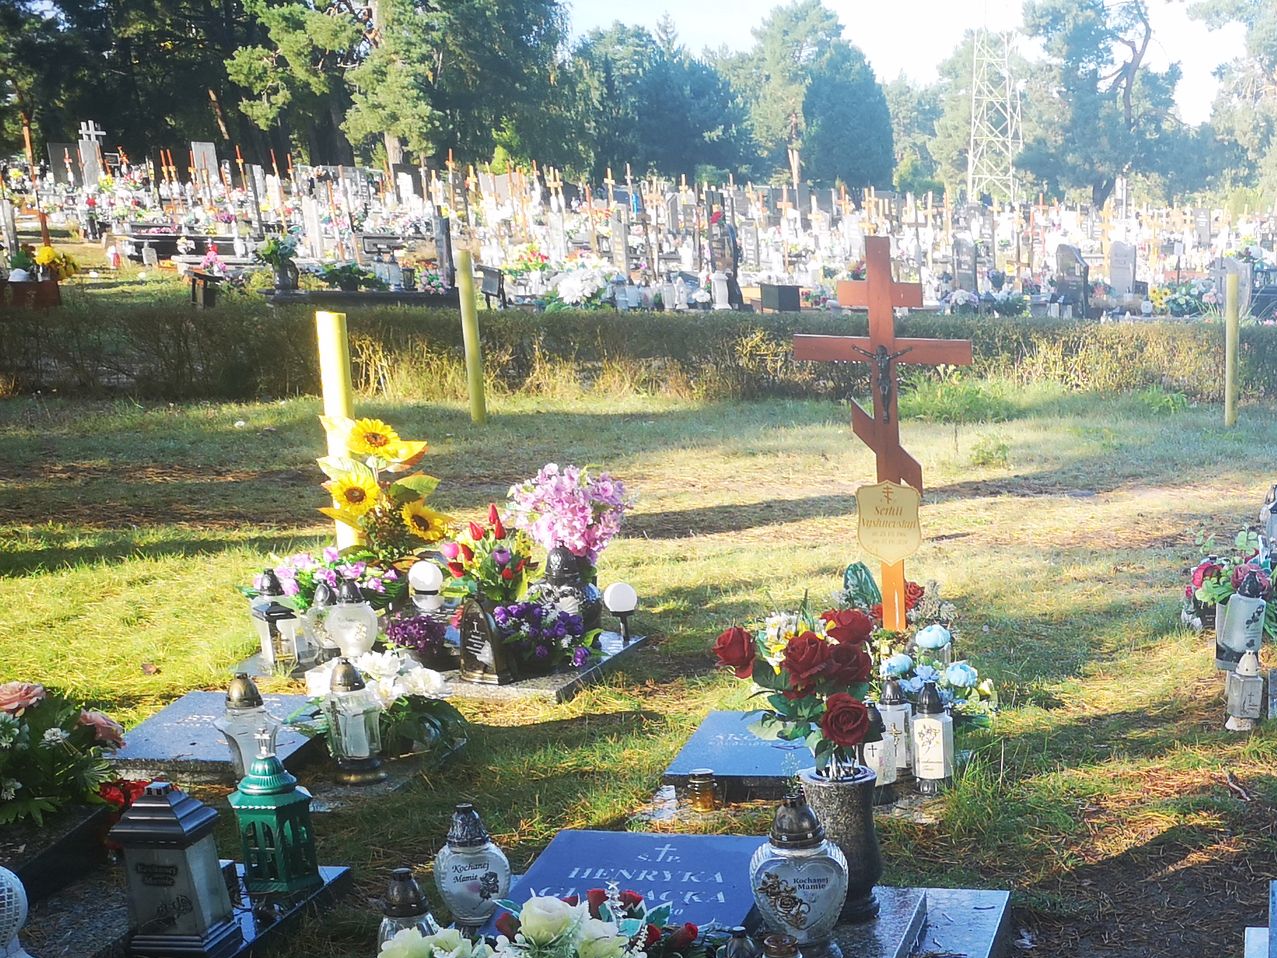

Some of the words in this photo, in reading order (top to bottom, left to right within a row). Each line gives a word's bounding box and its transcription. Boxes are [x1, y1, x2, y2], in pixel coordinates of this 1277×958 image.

[452, 862, 490, 875] Kochanej
[453, 874, 478, 884] Mamie
[568, 867, 724, 884] HENRYKA
[793, 877, 829, 885] Kochanej
